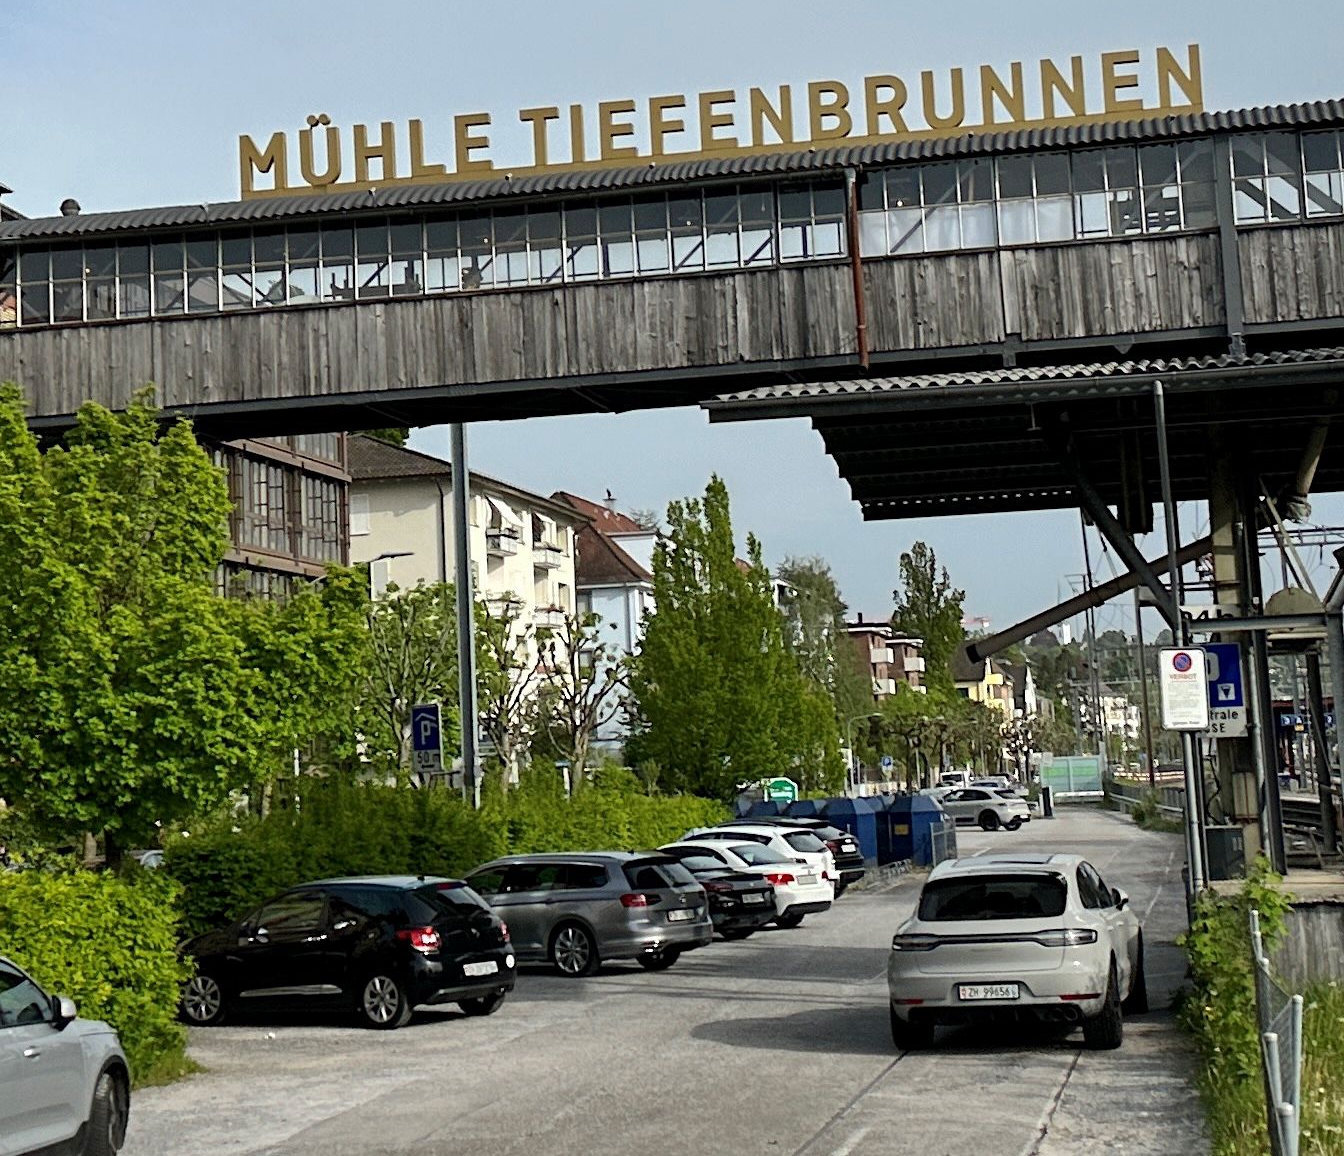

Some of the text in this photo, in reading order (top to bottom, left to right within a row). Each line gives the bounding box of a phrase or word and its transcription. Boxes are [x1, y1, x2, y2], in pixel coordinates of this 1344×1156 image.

[239, 45, 1203, 194] MÜHLE TIEFENBRUNNEN
[420, 720, 431, 746] P
[417, 751, 430, 764] 50
